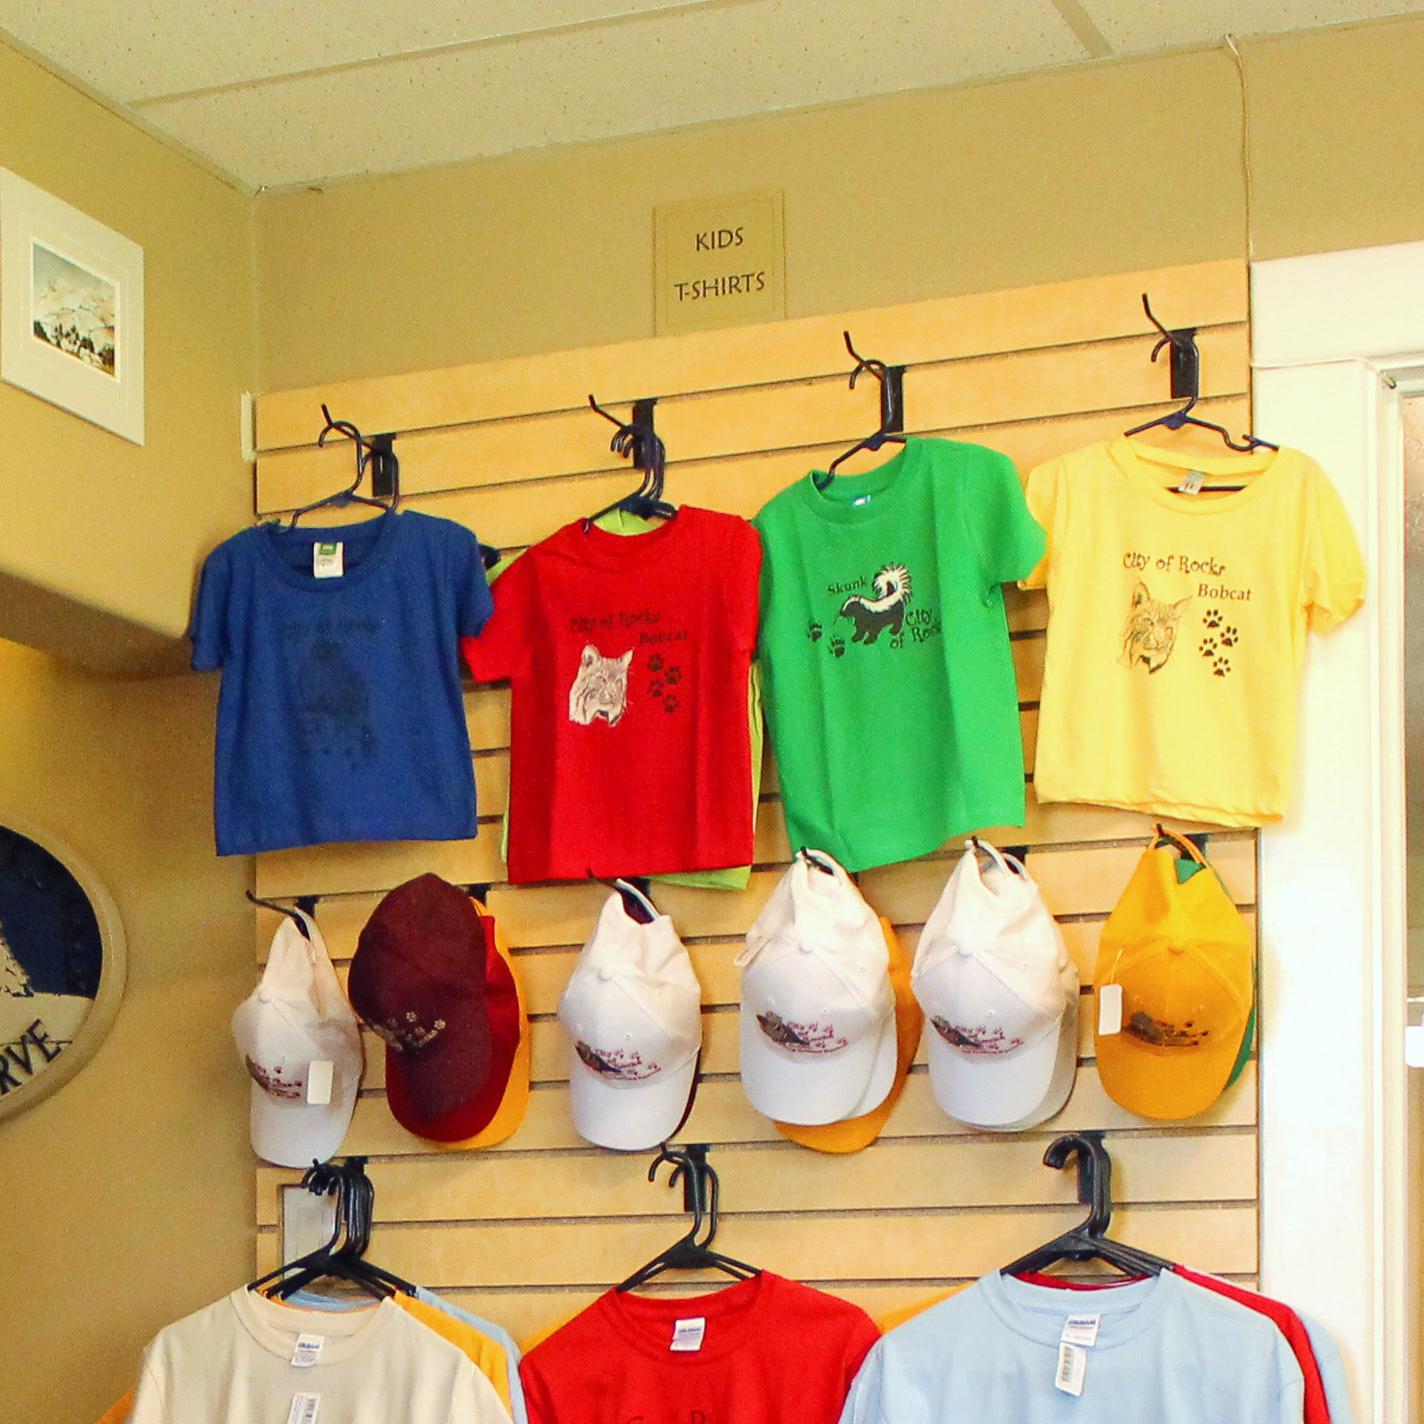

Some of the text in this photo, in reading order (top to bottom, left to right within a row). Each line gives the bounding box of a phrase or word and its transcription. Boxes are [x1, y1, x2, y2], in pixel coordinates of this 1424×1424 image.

[695, 227, 744, 252] KIDS
[674, 271, 765, 301] T-SHIRTS
[1123, 551, 1226, 577] City of Rocks
[828, 576, 868, 596] Skunk
[1197, 583, 1252, 602] Bobcat
[906, 608, 932, 627] City
[890, 632, 904, 649] of
